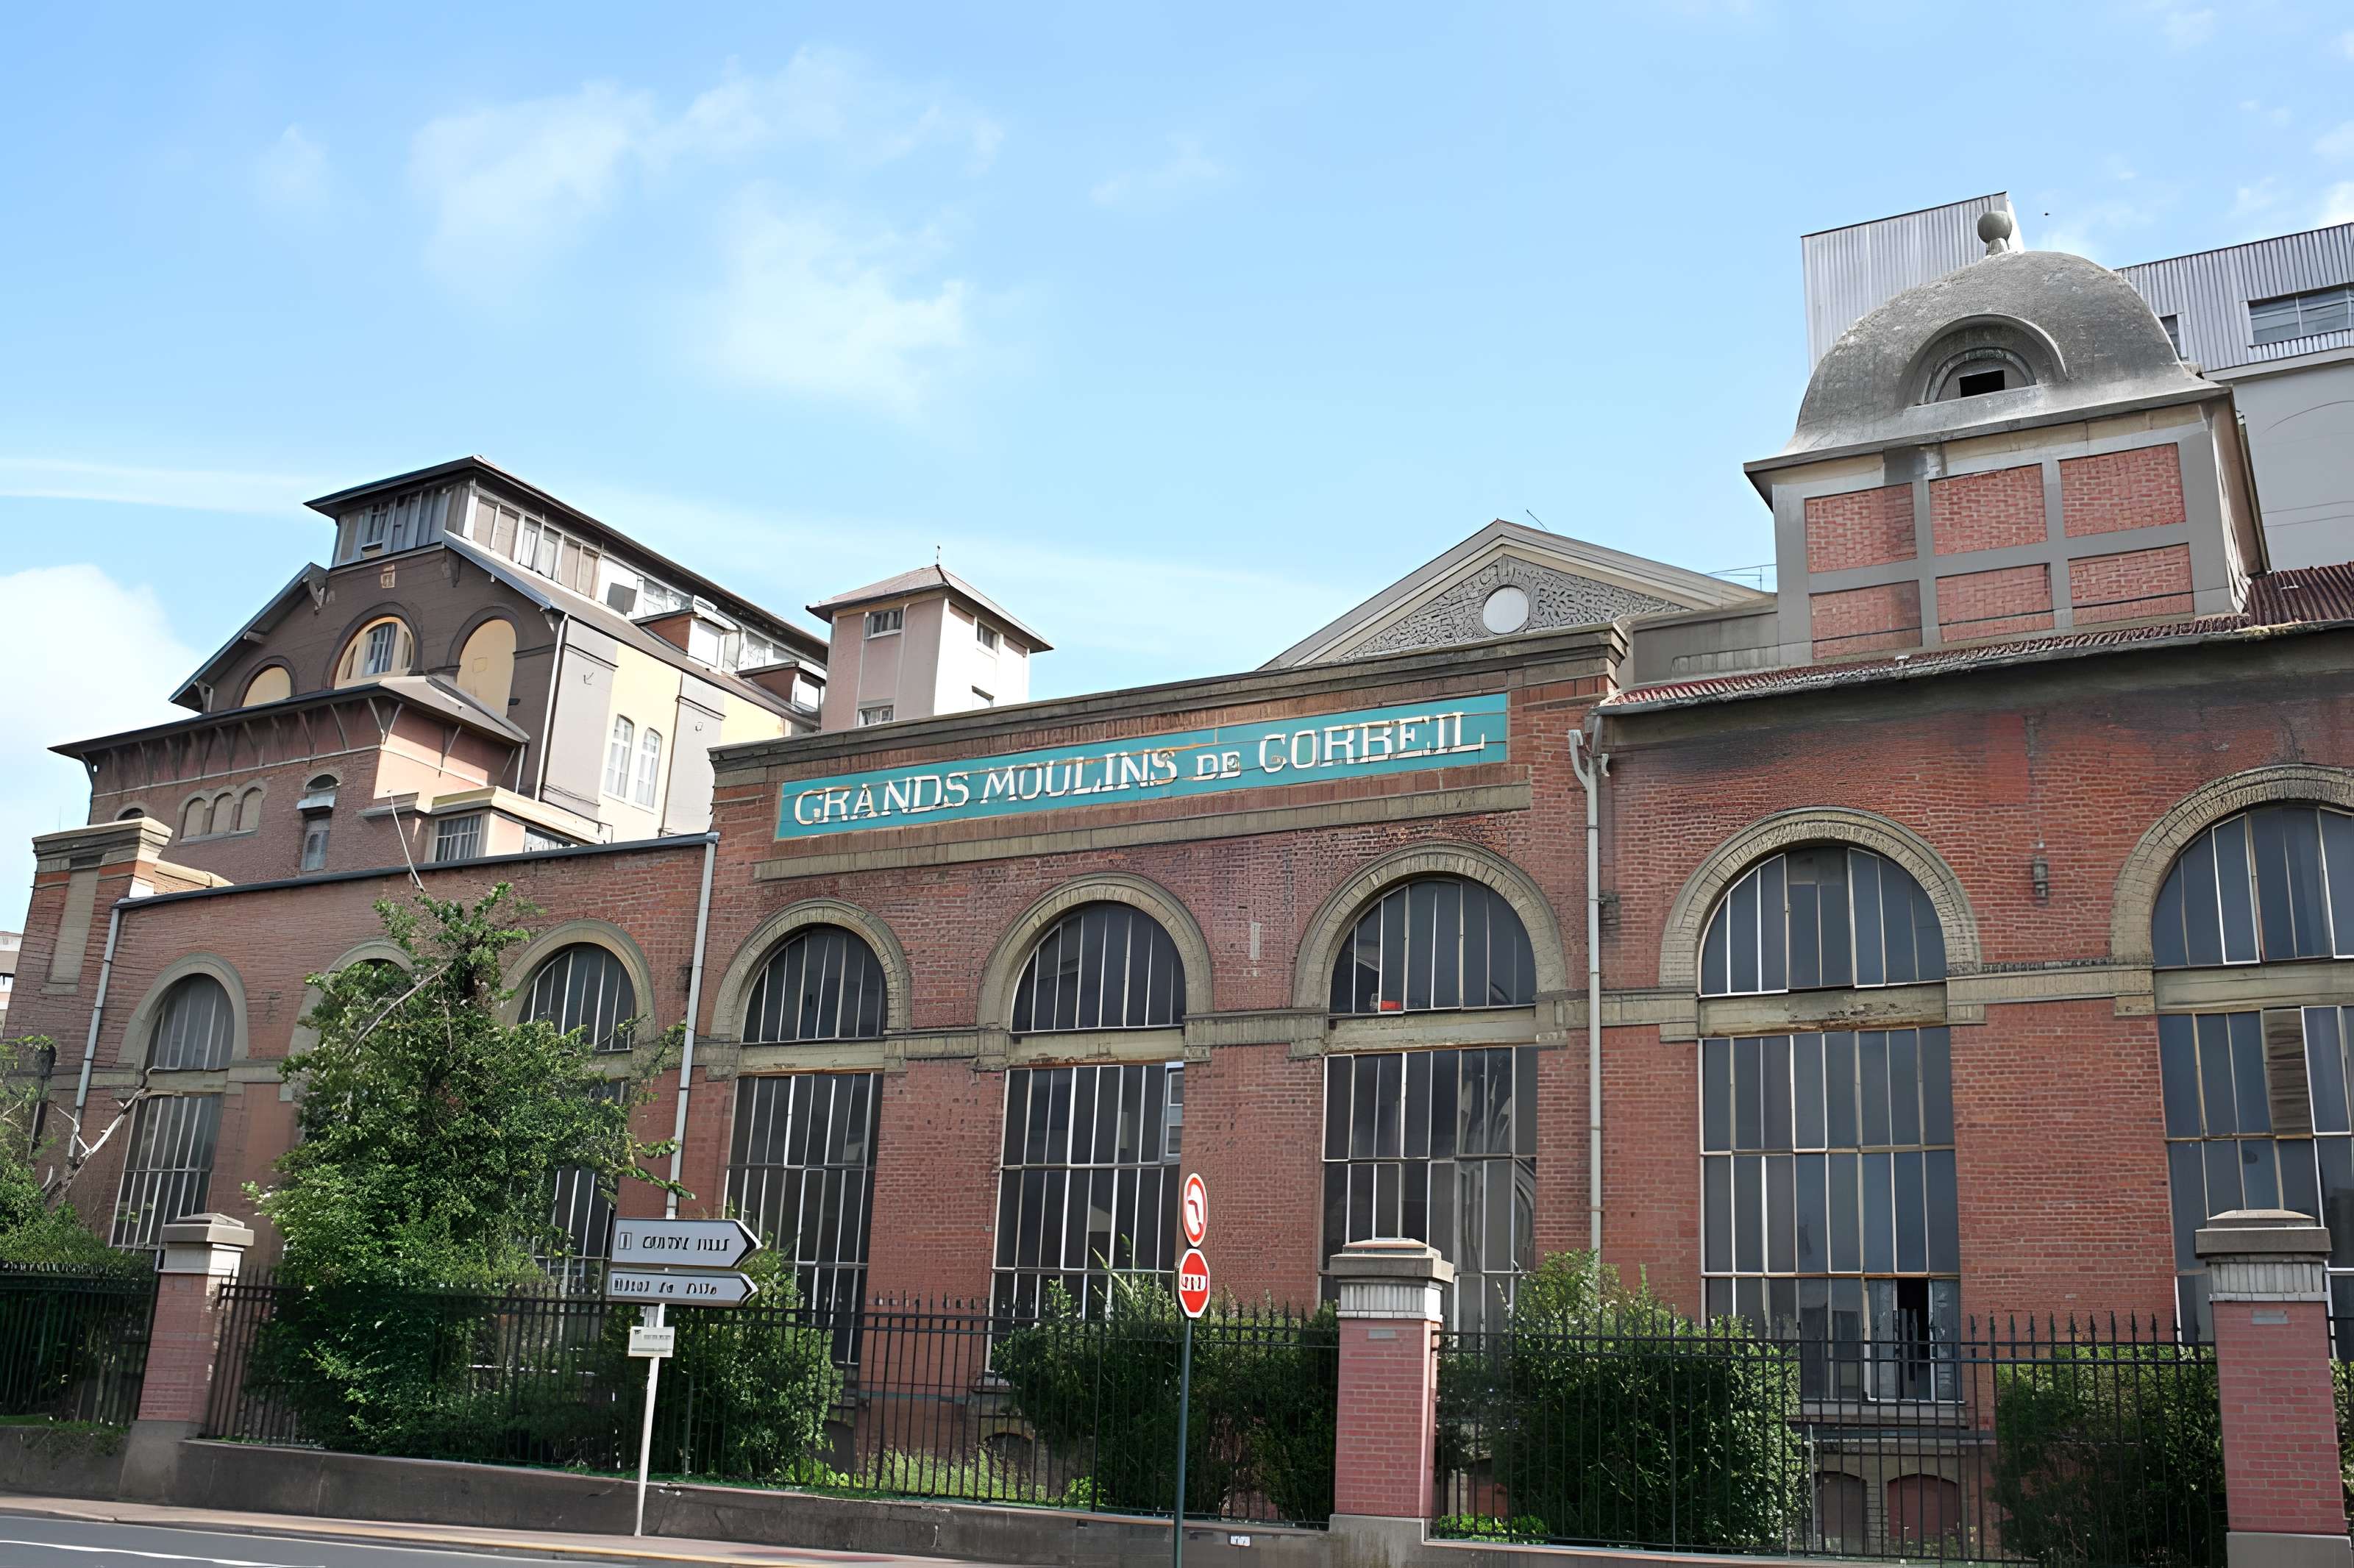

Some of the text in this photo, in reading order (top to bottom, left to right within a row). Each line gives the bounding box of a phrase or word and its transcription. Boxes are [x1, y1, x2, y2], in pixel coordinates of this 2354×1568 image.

[794, 771, 970, 825] GRANDS
[980, 749, 1177, 805] MOULINS
[1192, 751, 1241, 781] DE
